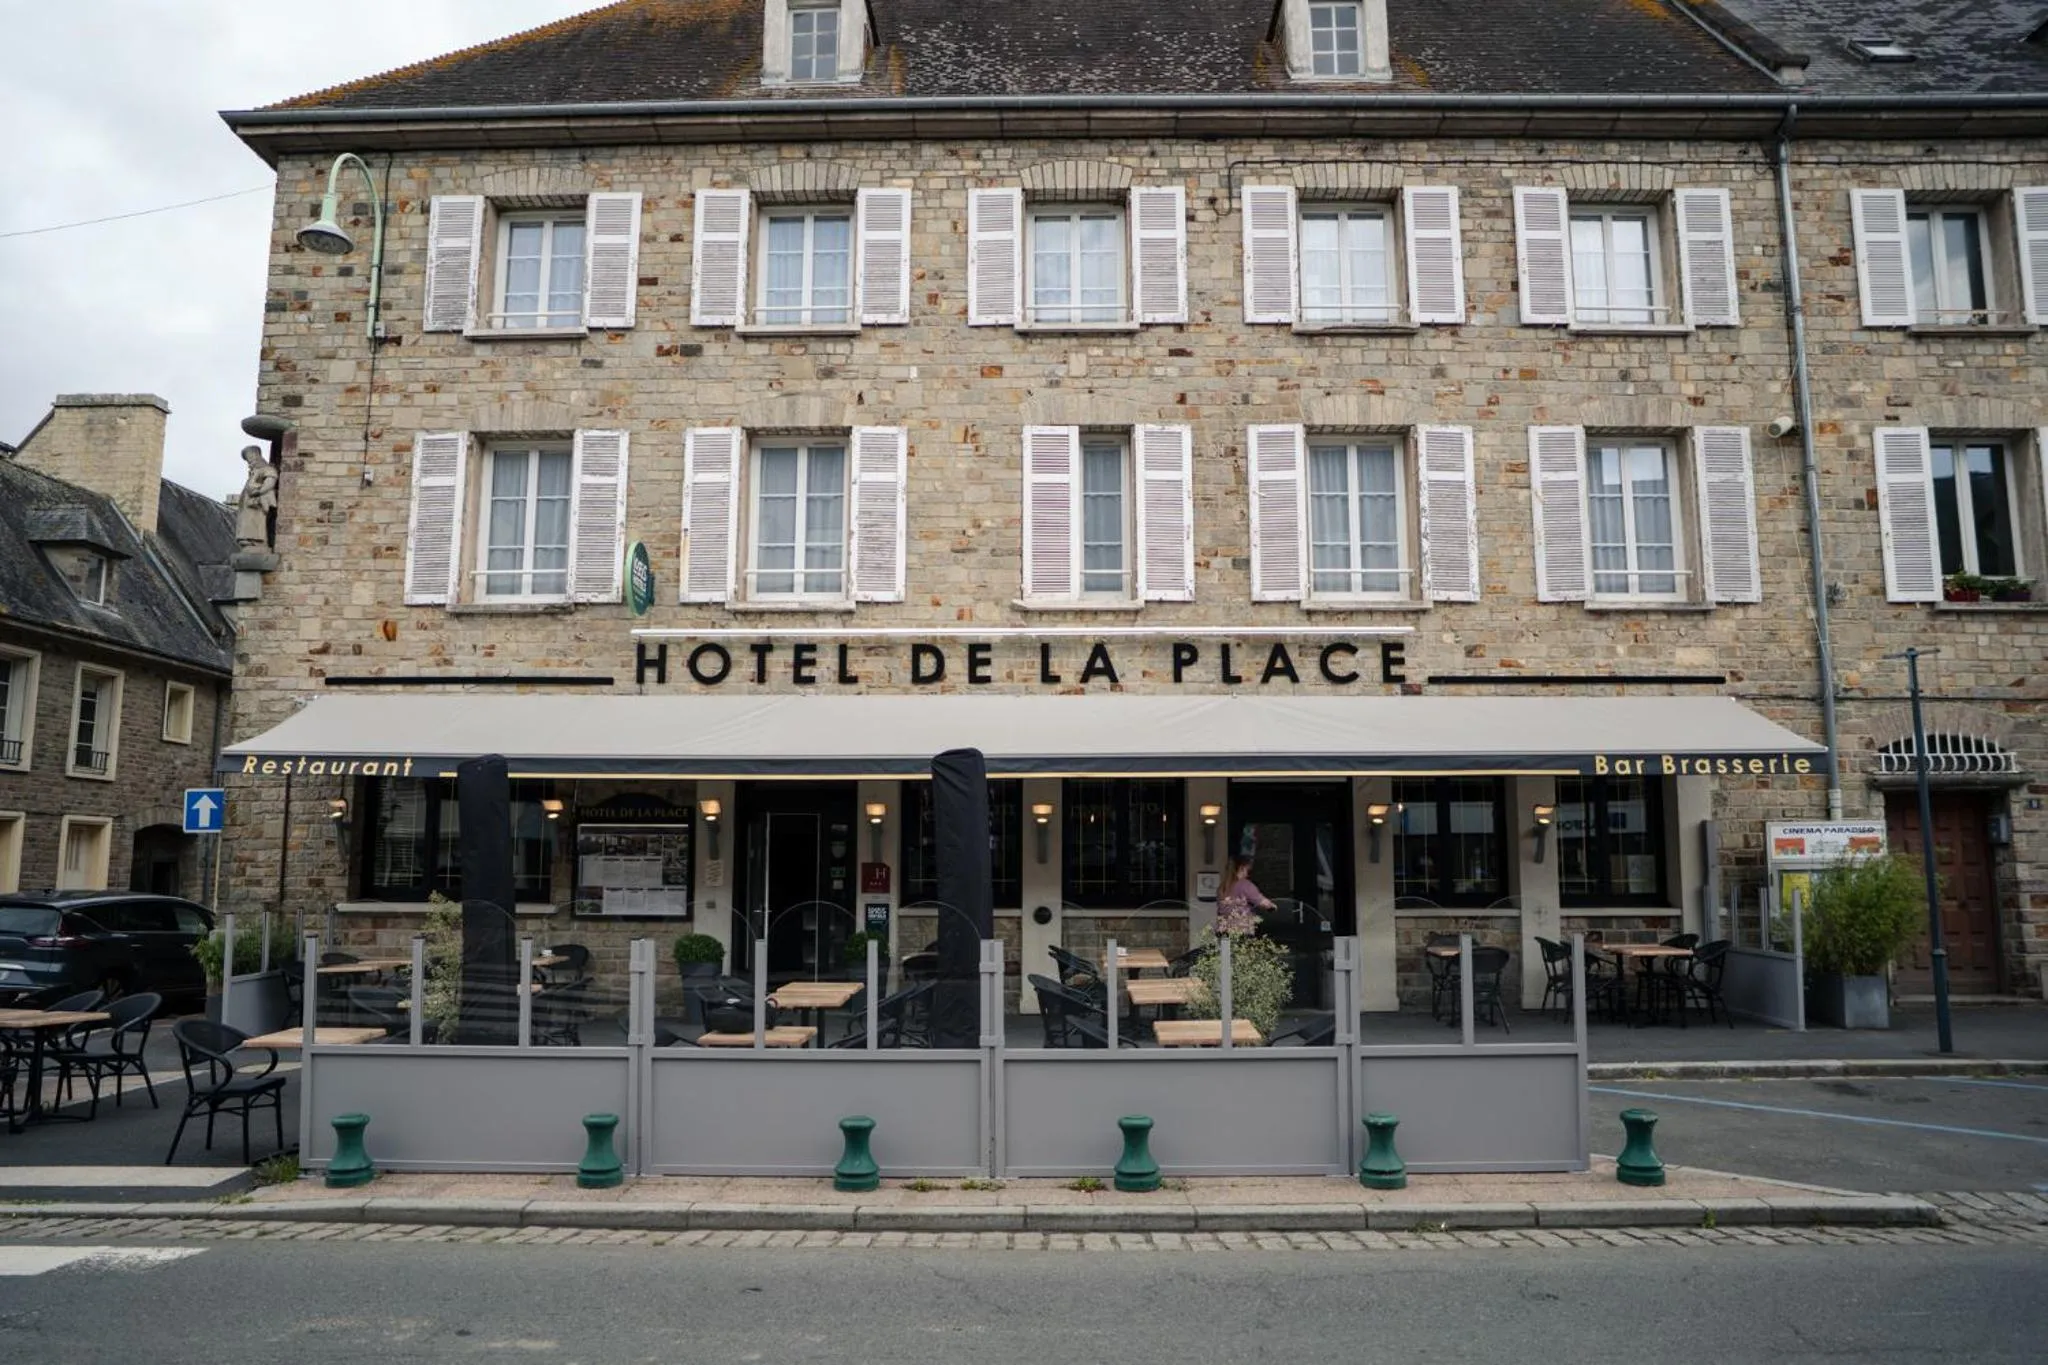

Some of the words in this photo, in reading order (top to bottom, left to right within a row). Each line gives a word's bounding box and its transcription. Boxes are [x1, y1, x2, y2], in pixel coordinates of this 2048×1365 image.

[636, 642, 858, 686] HOTEL
[911, 643, 992, 685] DE
[1040, 642, 1119, 685] LA
[1172, 641, 1406, 685] PLACE
[242, 756, 413, 776] Restaurant
[1595, 755, 1645, 775] Bar
[1661, 754, 1811, 775] Brasserie
